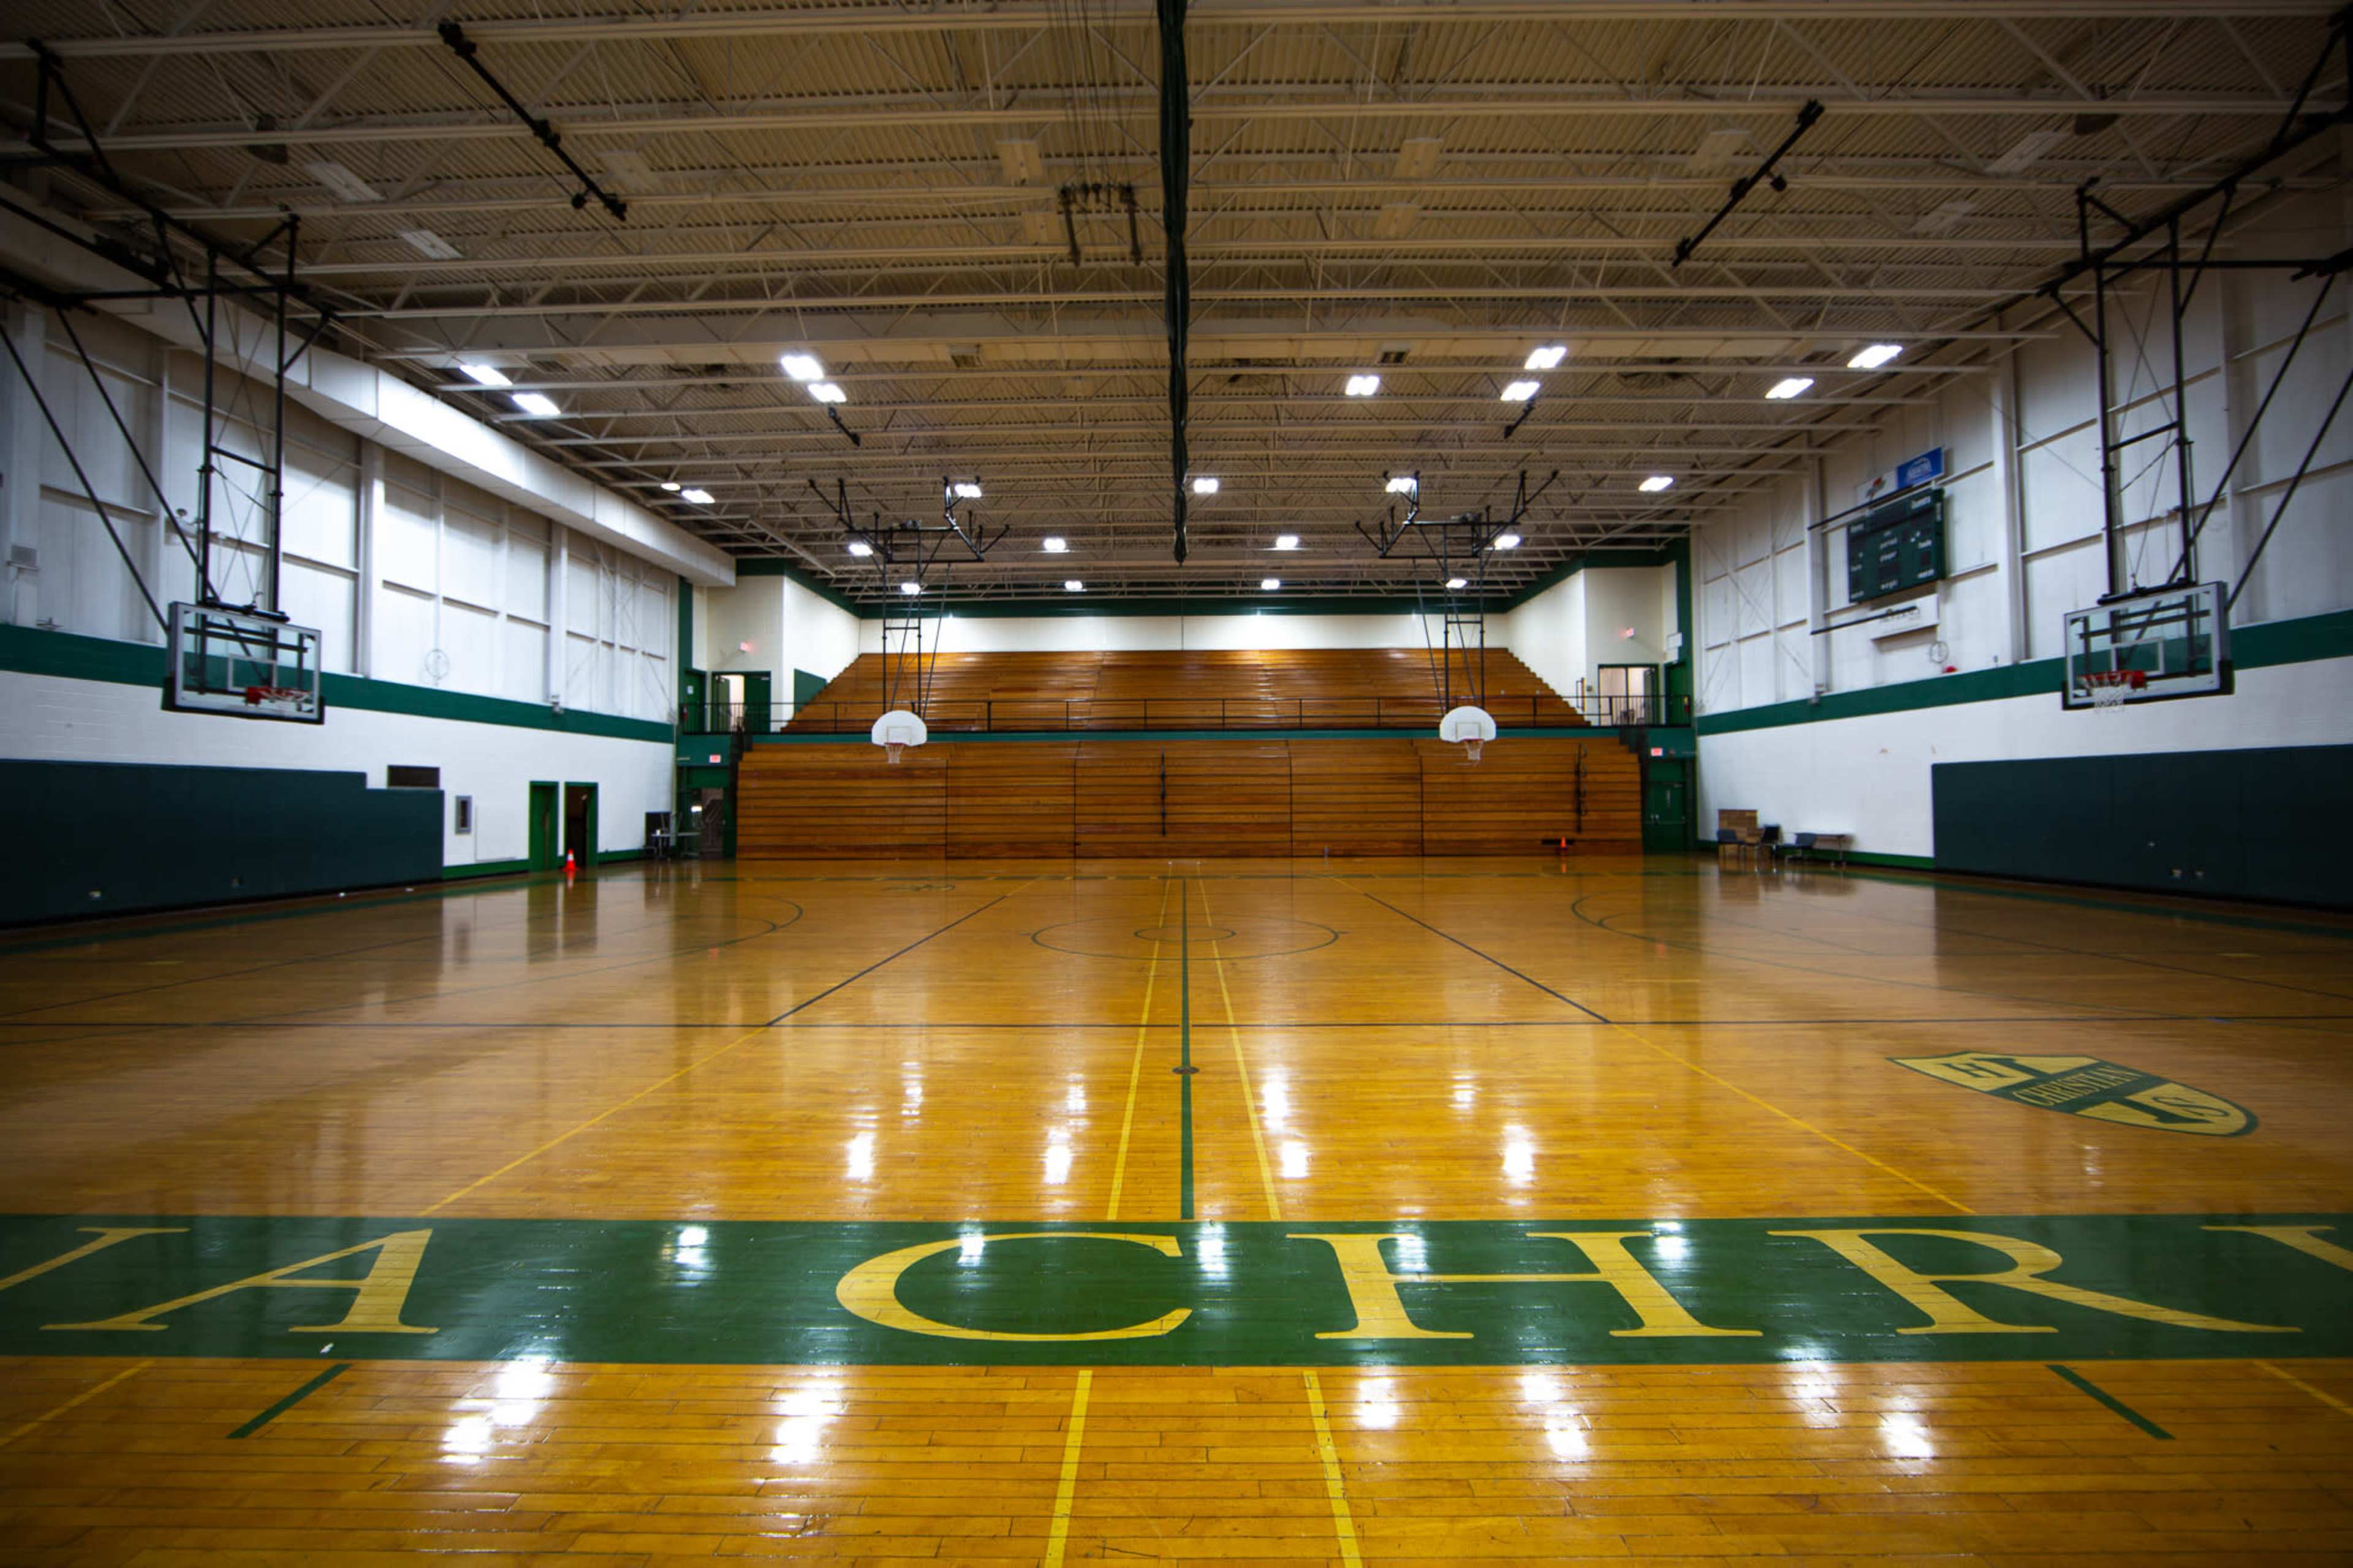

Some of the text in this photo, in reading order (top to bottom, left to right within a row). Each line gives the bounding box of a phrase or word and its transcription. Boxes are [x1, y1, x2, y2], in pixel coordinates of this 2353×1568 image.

[1934, 1062, 2017, 1078] H
[2012, 1066, 2143, 1106] CHRISTIAN
[2151, 1095, 2230, 1118] S
